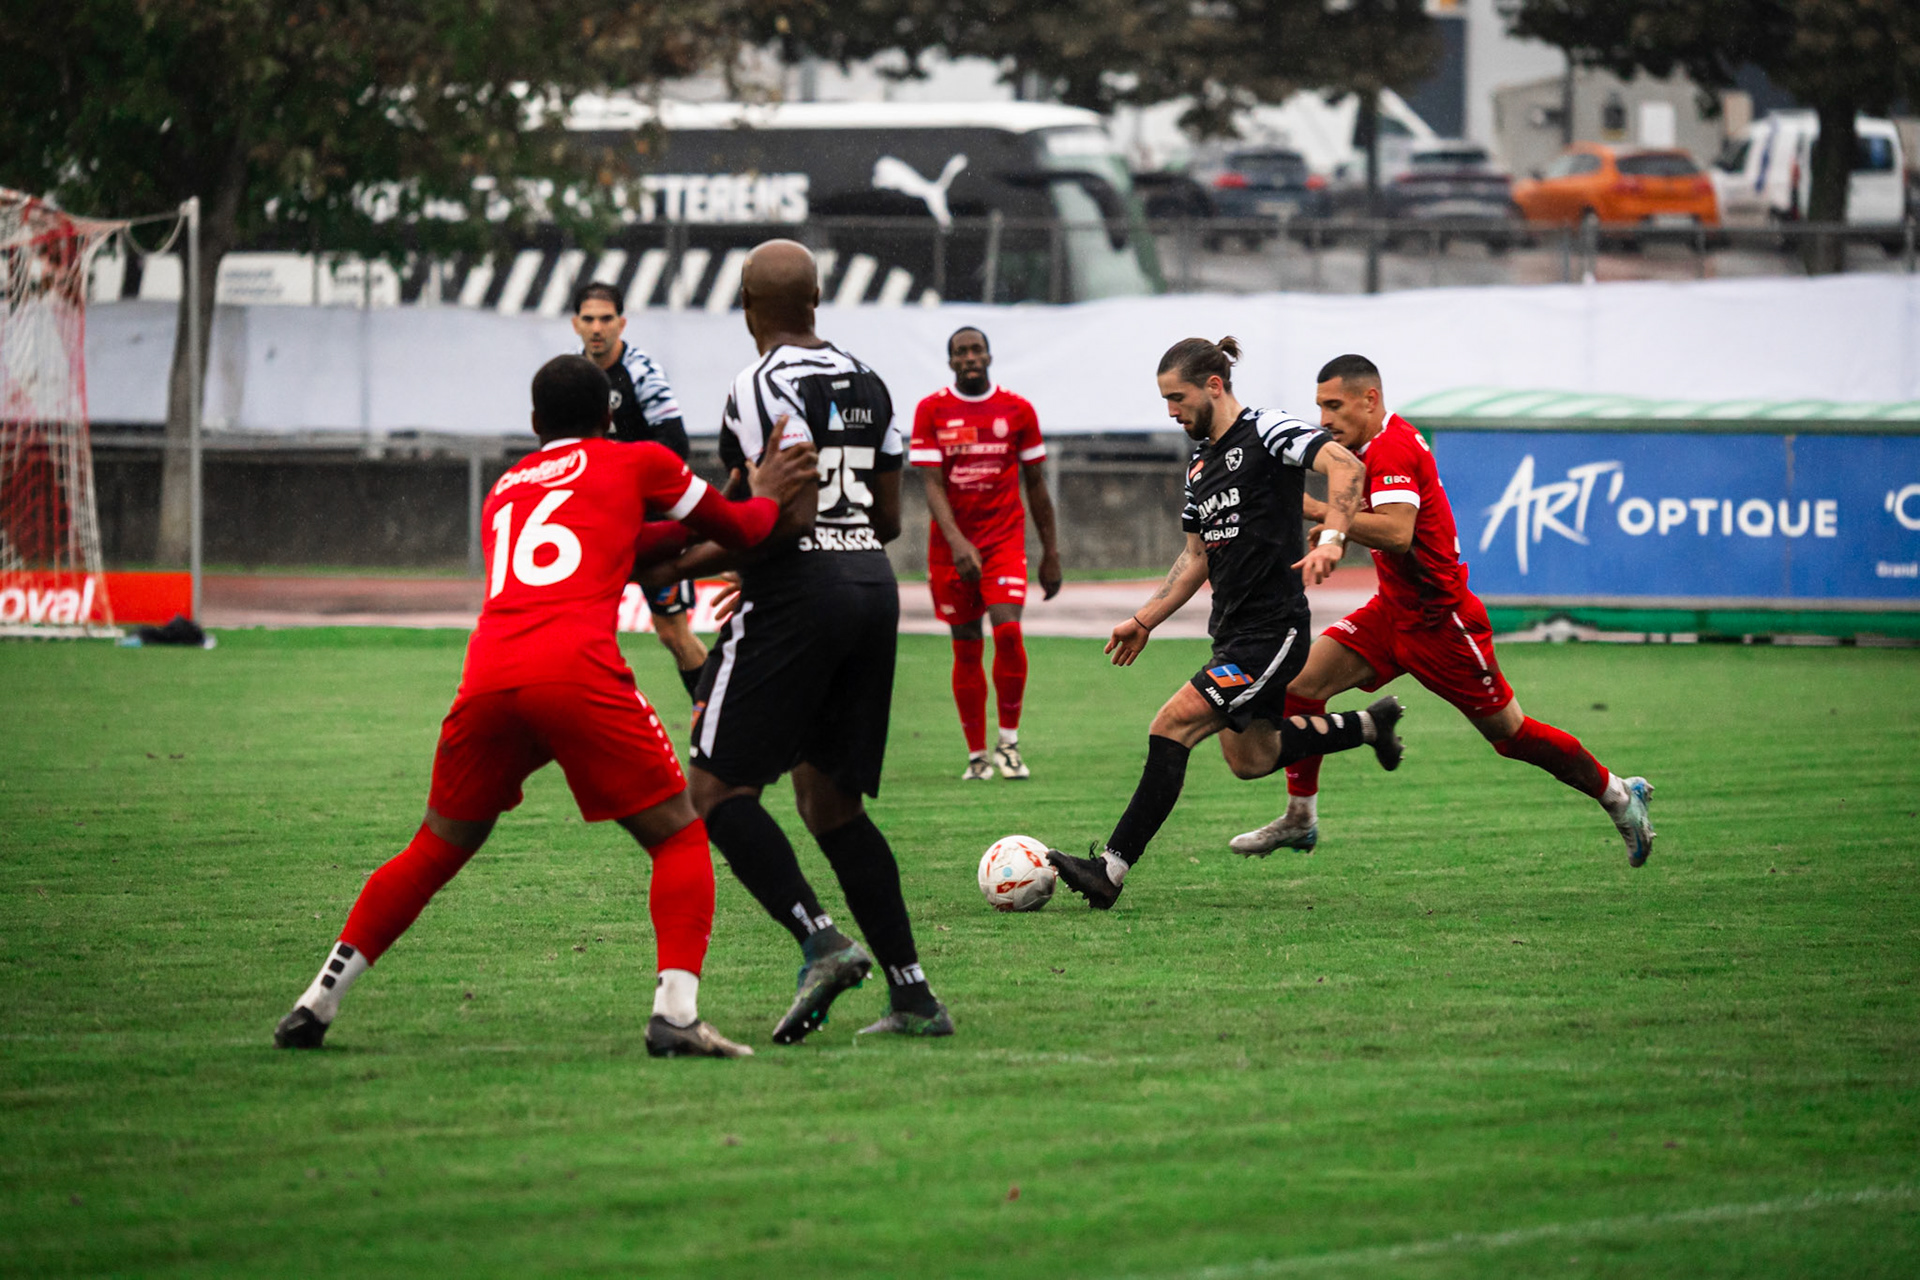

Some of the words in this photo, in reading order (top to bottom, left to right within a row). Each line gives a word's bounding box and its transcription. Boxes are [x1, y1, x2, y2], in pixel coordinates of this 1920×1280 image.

[816, 446, 876, 525] 25
[1393, 475, 1412, 484] BCV
[490, 489, 583, 600] 16
[1205, 686, 1225, 706] JAKO
